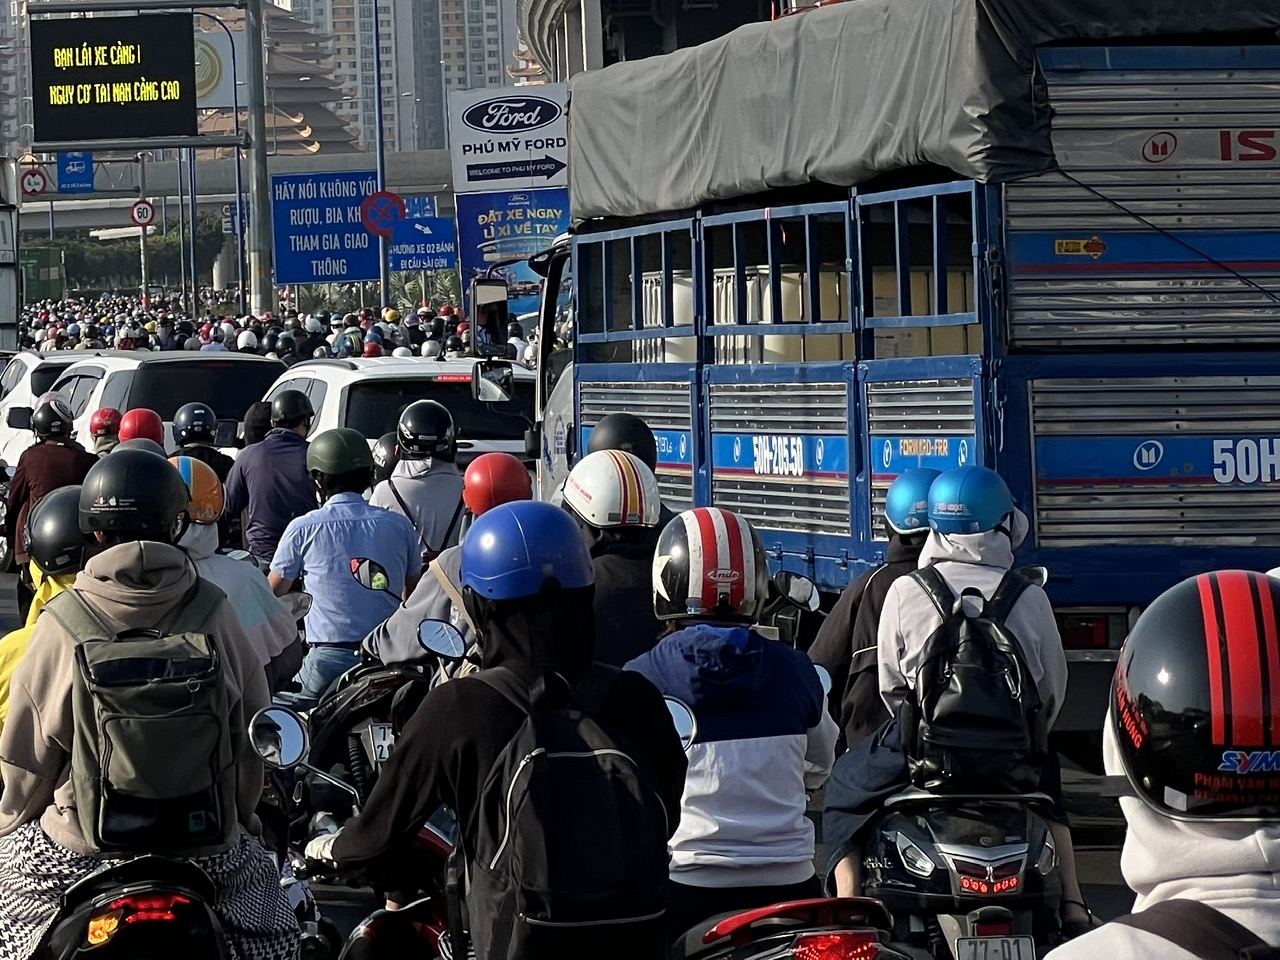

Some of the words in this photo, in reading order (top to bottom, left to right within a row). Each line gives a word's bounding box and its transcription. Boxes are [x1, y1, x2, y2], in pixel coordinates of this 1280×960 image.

[54, 47, 73, 70] BẠN
[76, 42, 92, 66] LÁI
[94, 46, 108, 66] XE
[110, 41, 135, 65] CÀNG
[49, 85, 74, 105] NGUY
[76, 84, 91, 104] CƠ
[94, 83, 110, 103] TAI
[112, 82, 132, 105] NẠN
[134, 77, 158, 102] CÀNG
[161, 80, 180, 100] CAO
[482, 102, 541, 127] Ford
[462, 139, 494, 155] PHÚ
[498, 137, 521, 152] MỸ
[525, 137, 567, 150] FORD
[1220, 130, 1277, 161] IS
[469, 167, 501, 176] WELCOME
[537, 163, 556, 171] FORD
[275, 181, 295, 200] HÃY
[298, 179, 317, 199] NÓI
[320, 179, 356, 199] KHÔNG
[359, 176, 377, 196] VỚI
[137, 207, 148, 219] 60
[325, 207, 343, 224] BIA
[347, 206, 362, 223] KH
[506, 208, 524, 220] XE
[527, 208, 563, 219] NGAY
[534, 224, 558, 234] TAY
[290, 235, 319, 252] THAM
[322, 234, 340, 250] GIA
[344, 233, 368, 249] GIAO
[416, 243, 425, 254] XE
[426, 243, 435, 254] 02
[436, 240, 454, 253] BÁNH
[311, 257, 347, 276] THÔNG
[753, 436, 804, 477] 50H-205.50
[1213, 438, 1280, 483] 50H
[1218, 750, 1280, 774] SYM
